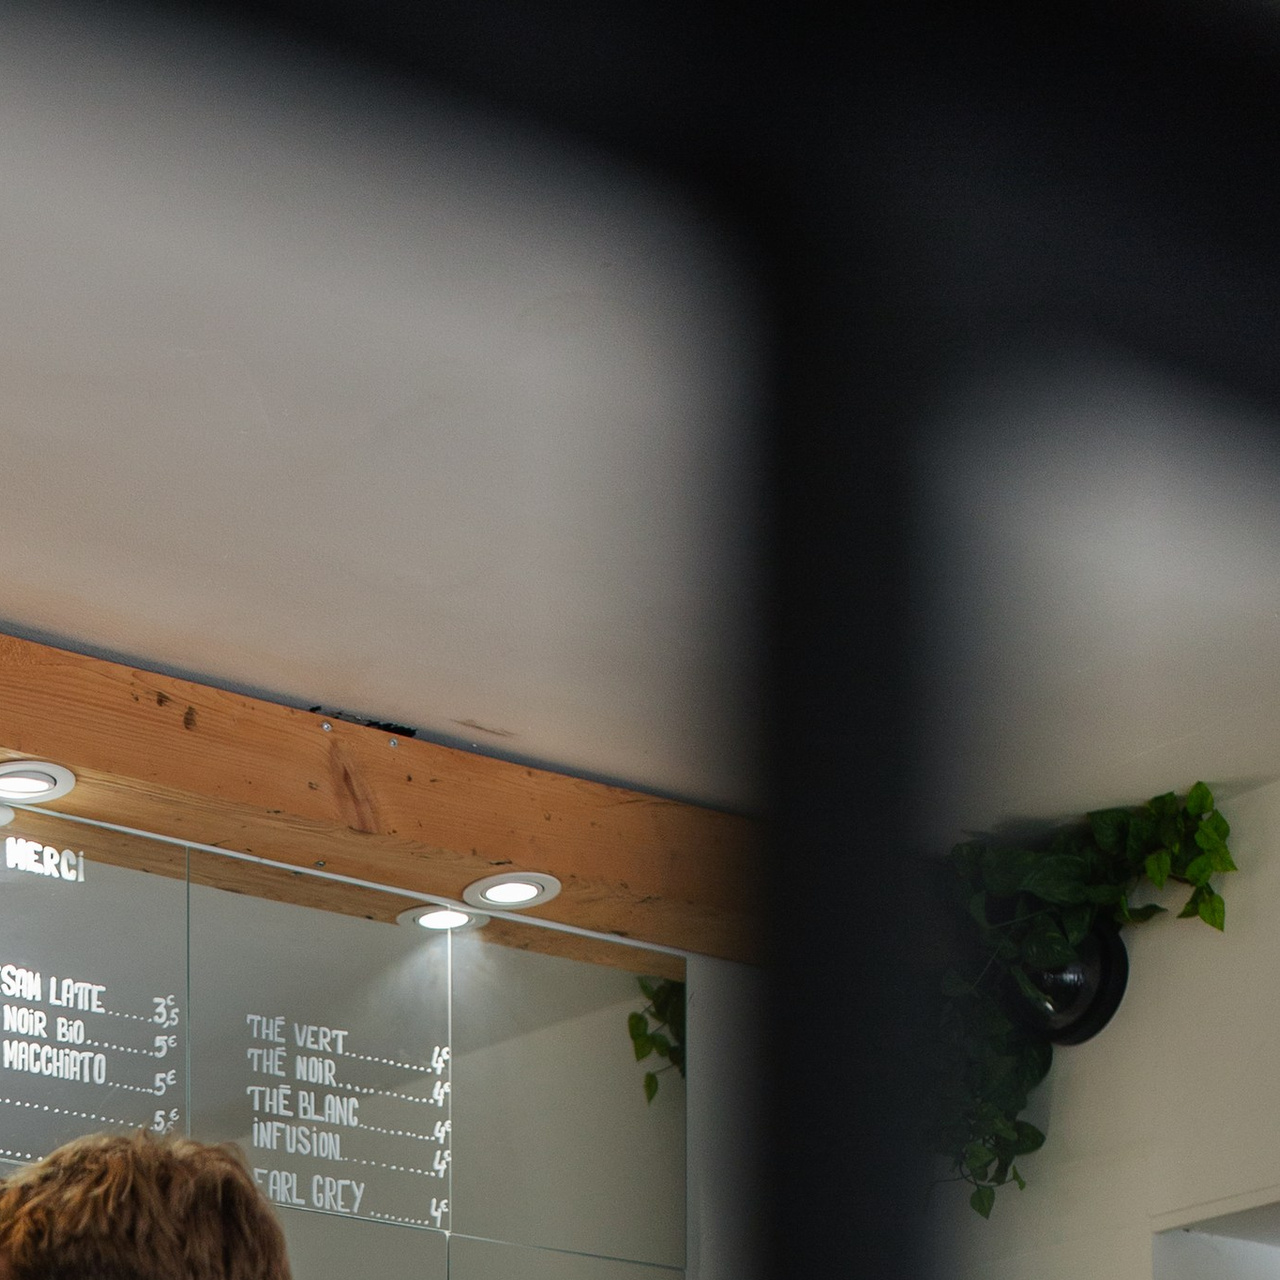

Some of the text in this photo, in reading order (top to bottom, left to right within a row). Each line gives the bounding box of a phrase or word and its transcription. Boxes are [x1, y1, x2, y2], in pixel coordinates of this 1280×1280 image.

[49, 976, 107, 1014] LATTE
[246, 1013, 287, 1044] THÉ
[294, 1022, 349, 1055] VERT
[246, 1046, 287, 1077] THÉ
[246, 1084, 294, 1117] THÉ
[297, 1090, 360, 1127] BLANC
[312, 1174, 365, 1214] GREY
